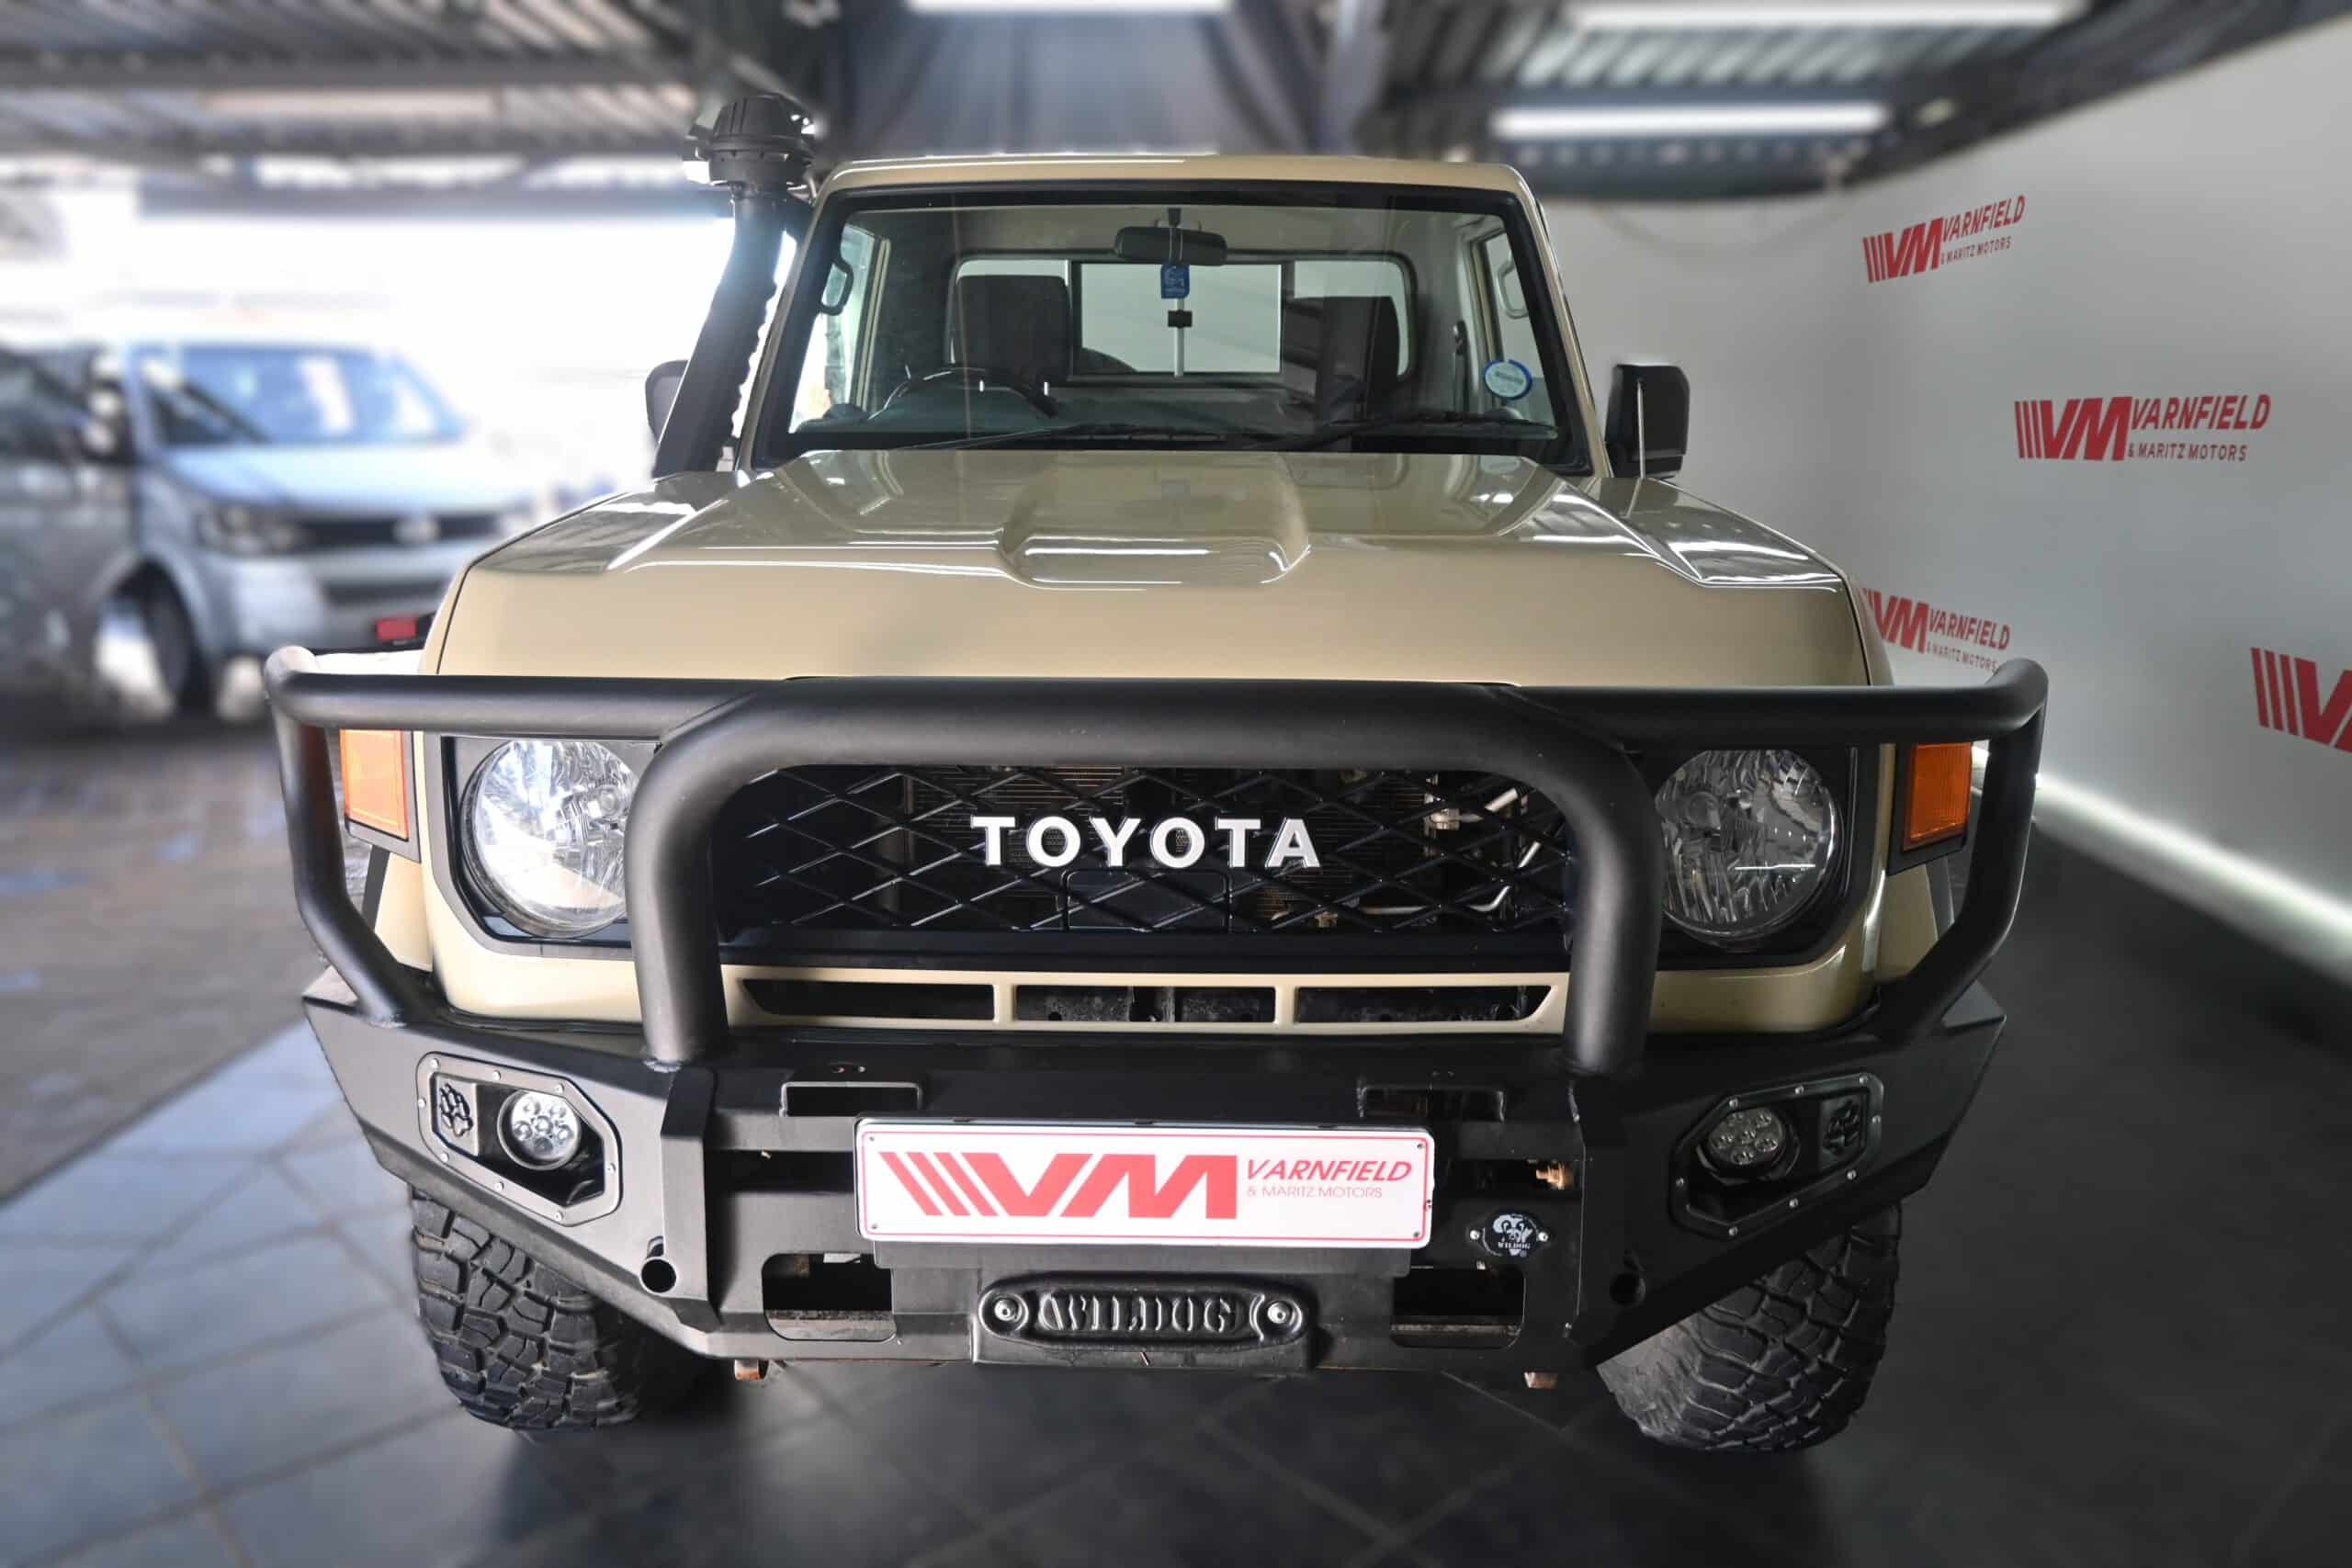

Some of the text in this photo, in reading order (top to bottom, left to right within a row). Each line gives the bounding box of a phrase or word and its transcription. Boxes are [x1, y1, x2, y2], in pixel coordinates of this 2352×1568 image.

[1942, 195, 2026, 243] VARNFIELD
[1976, 235, 2012, 256] MOTORS
[2040, 397, 2132, 461] VM
[2132, 394, 2271, 430] VARNFIELD
[2138, 443, 2186, 459] MARITZ
[2188, 443, 2248, 462] MOTORS
[1929, 608, 2010, 650] VARNFIELD
[970, 816, 1320, 868] TOYOTA
[961, 1152, 1237, 1219] VM
[1248, 1159, 1412, 1181] VARNFIELD
[1247, 1186, 1383, 1199] & MARITZ MOTORS
